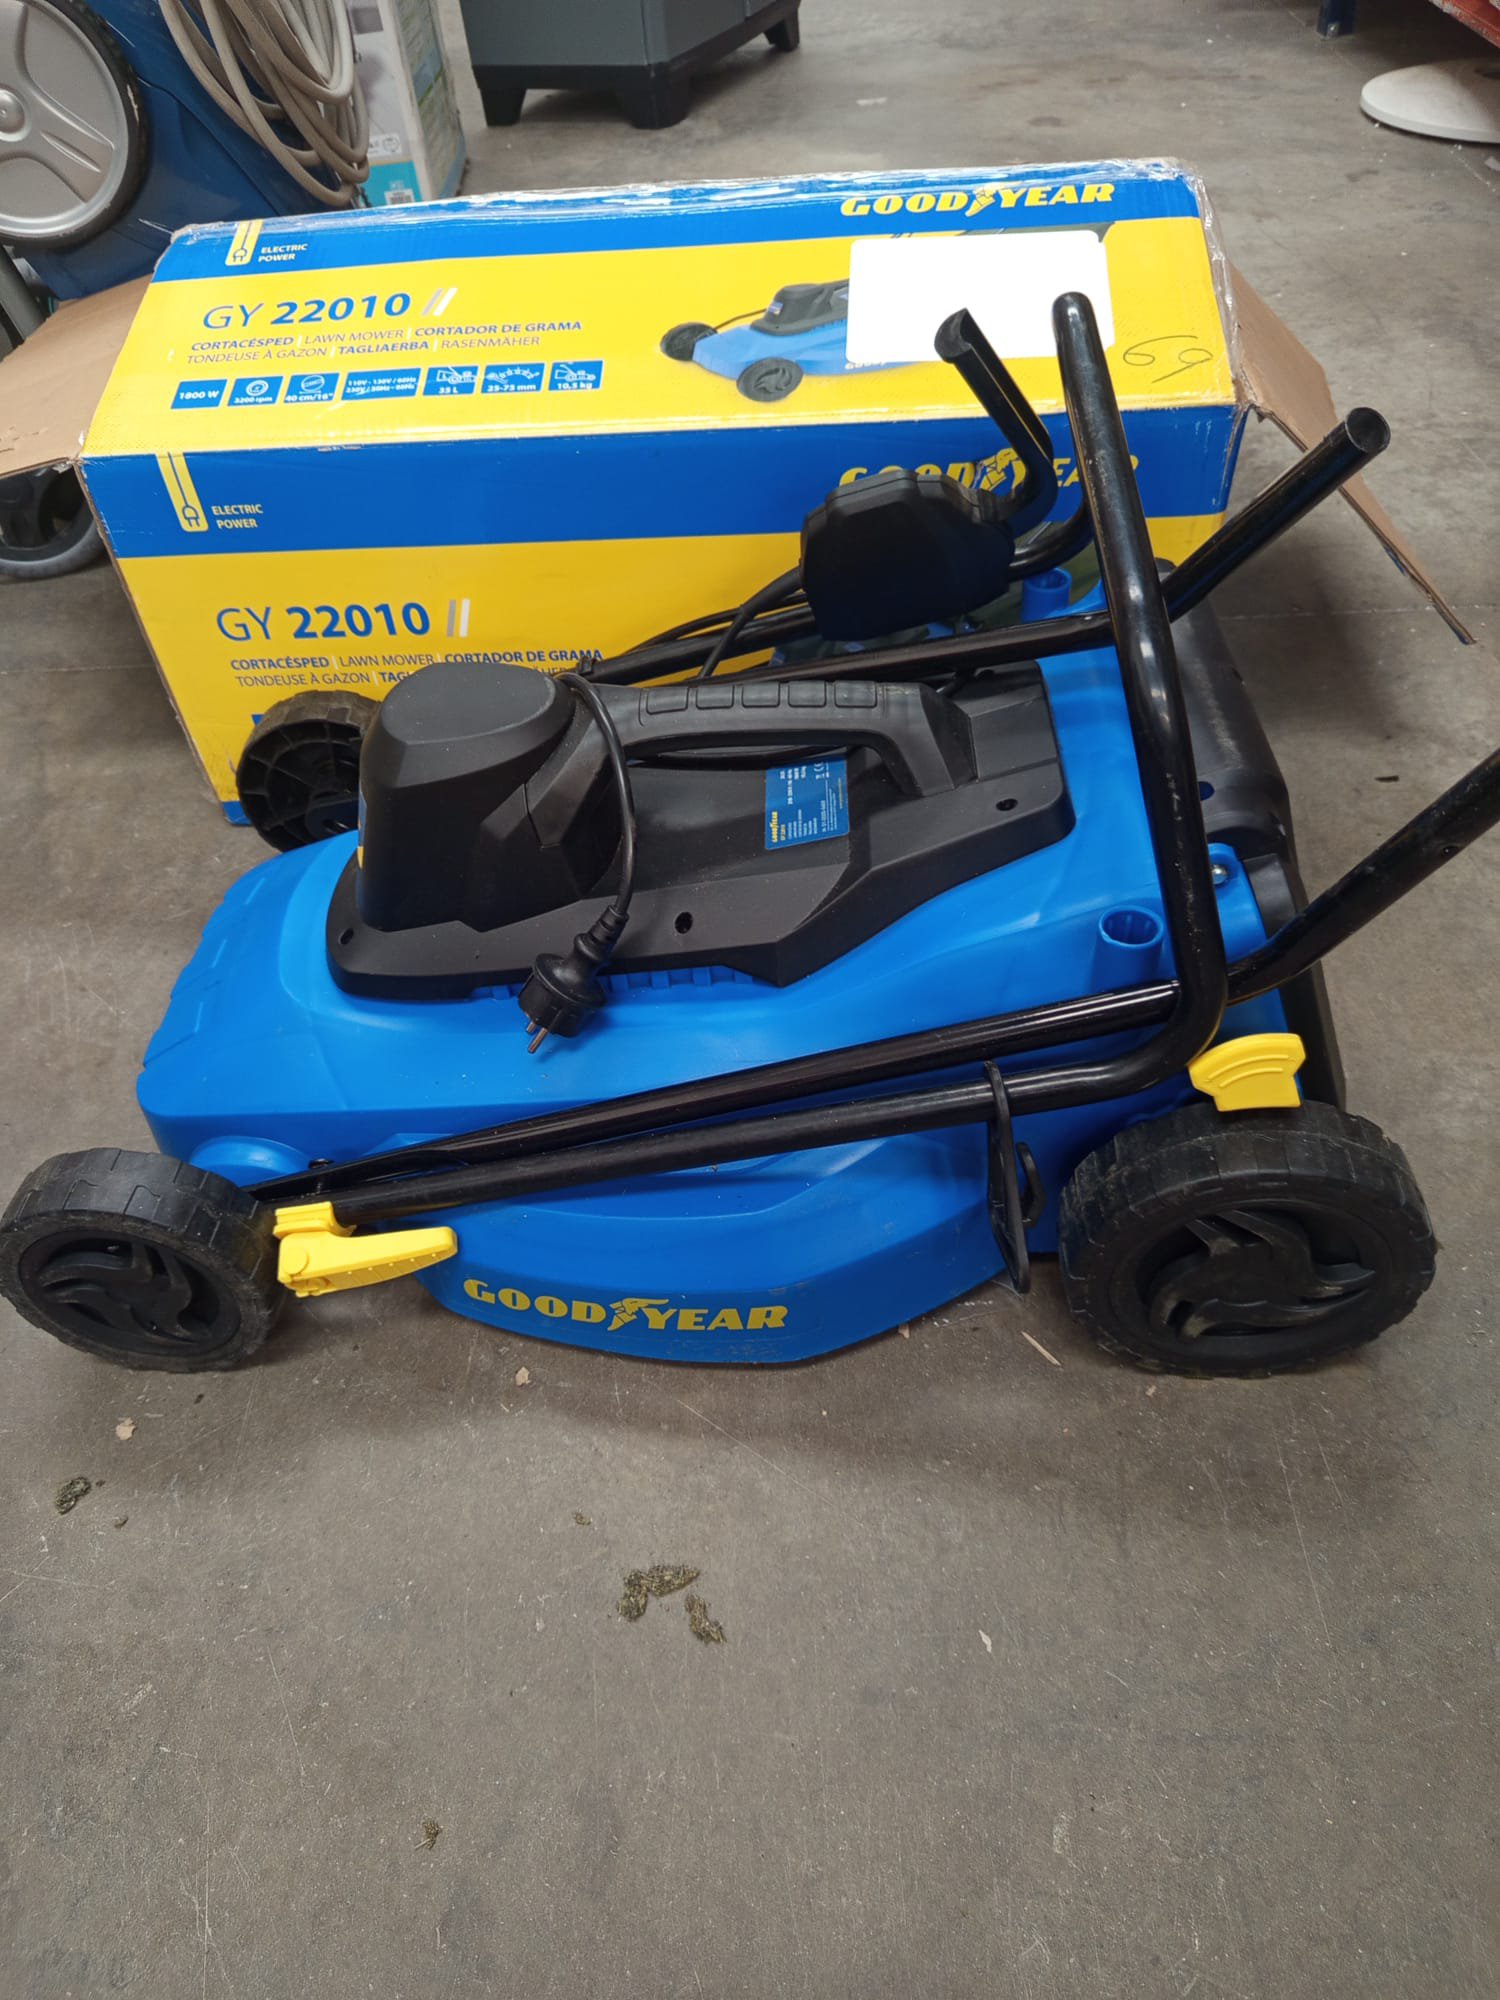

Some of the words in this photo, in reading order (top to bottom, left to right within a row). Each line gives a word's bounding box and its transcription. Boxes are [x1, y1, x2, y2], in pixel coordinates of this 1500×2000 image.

[260, 243, 309, 255] ELECTRIC
[257, 253, 296, 263] POWER
[203, 302, 265, 329] GY
[271, 292, 411, 325] 22010
[191, 335, 295, 352] CORTACÉSPED
[304, 333, 347, 345] LAWN
[349, 329, 404, 343] MOWER
[415, 324, 498, 337] CORTADOR
[501, 323, 522, 334] DE
[525, 320, 583, 333] GRAMA
[187, 351, 262, 364] TONDEUSE
[263, 348, 273, 360] À
[276, 346, 328, 359] GAZON
[338, 341, 430, 355] TAGLIAERBA
[441, 336, 541, 350] RASENMÄHER
[516, 383, 537, 391] mm
[579, 381, 593, 390] kg
[179, 391, 205, 400] 1800
[207, 389, 220, 398] W
[210, 503, 264, 516] ELECTRIC
[216, 518, 259, 530] POWER
[216, 606, 272, 642] GY
[286, 602, 430, 640] 22010
[230, 655, 330, 671] CORTACÉSPED
[339, 655, 379, 668] LAWN
[382, 652, 434, 666] MOWER
[444, 651, 524, 664] CORTADOR
[526, 650, 546, 662] DE
[235, 673, 308, 688] TONDEUSE
[310, 670, 320, 685] À
[322, 672, 371, 685] GAZON
[463, 1278, 789, 1331] GOODYEAR
